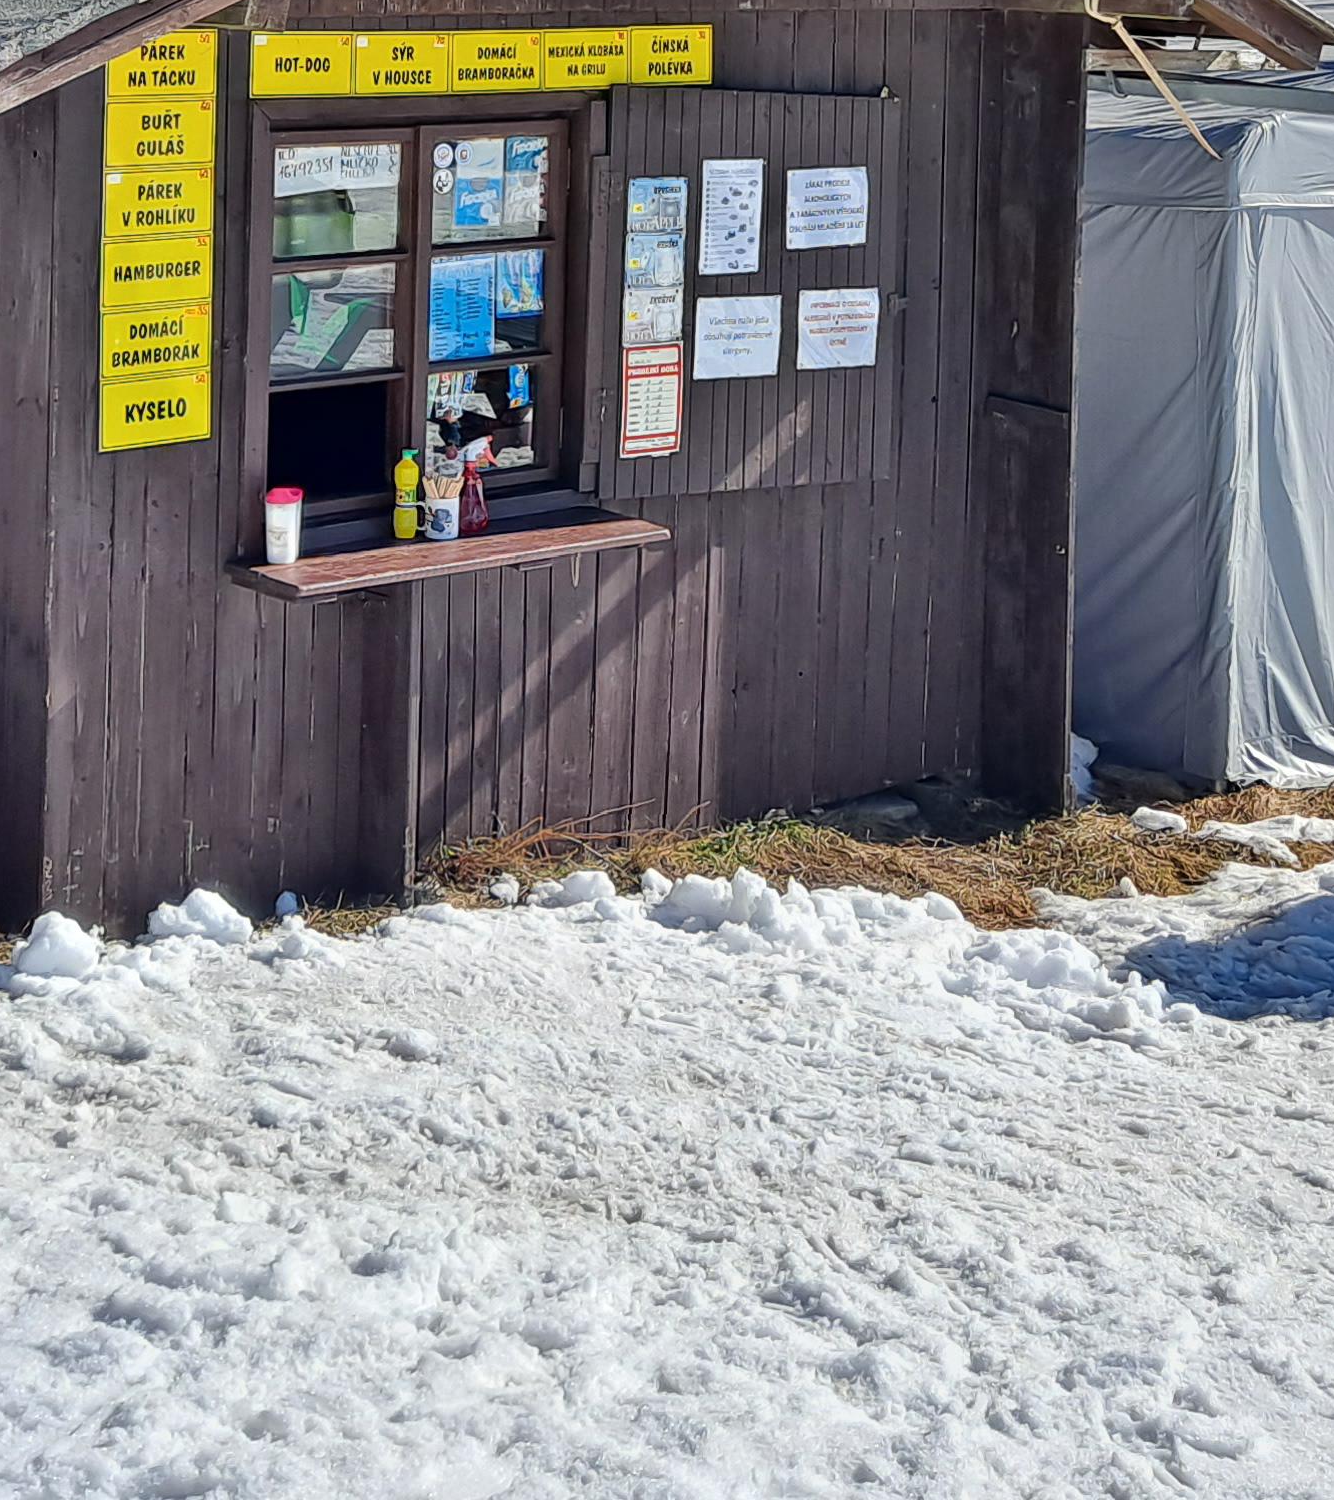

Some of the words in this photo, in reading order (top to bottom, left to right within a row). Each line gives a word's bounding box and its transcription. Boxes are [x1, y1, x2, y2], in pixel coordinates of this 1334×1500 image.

[140, 41, 185, 61] PÁREK
[392, 41, 415, 61] SÝR
[477, 43, 517, 60] DOMÁCÍ
[548, 41, 585, 58] MEXICKÁ
[651, 35, 690, 53] ČÍNSKÁ
[275, 57, 331, 73] HOT-DOG
[458, 63, 535, 81] BRAMBORAČKA
[567, 63, 579, 76] NA
[581, 63, 606, 76] GRILU
[648, 58, 693, 76] POLÉVKA
[128, 71, 147, 88] NA
[152, 65, 196, 87] TÁCKU
[372, 71, 380, 85] V
[385, 70, 432, 85] HOUSCE
[142, 109, 182, 131] BUŘT
[136, 134, 185, 157] GULÁŠ
[138, 180, 183, 201] PÁREK
[122, 211, 131, 227] V
[136, 204, 195, 227] ROHLÍKU
[114, 260, 201, 282] HAMBURGER
[129, 314, 184, 340] DOMÁCÍ
[112, 340, 200, 368] BRAMBORÁK
[125, 397, 187, 424] KYSELO
